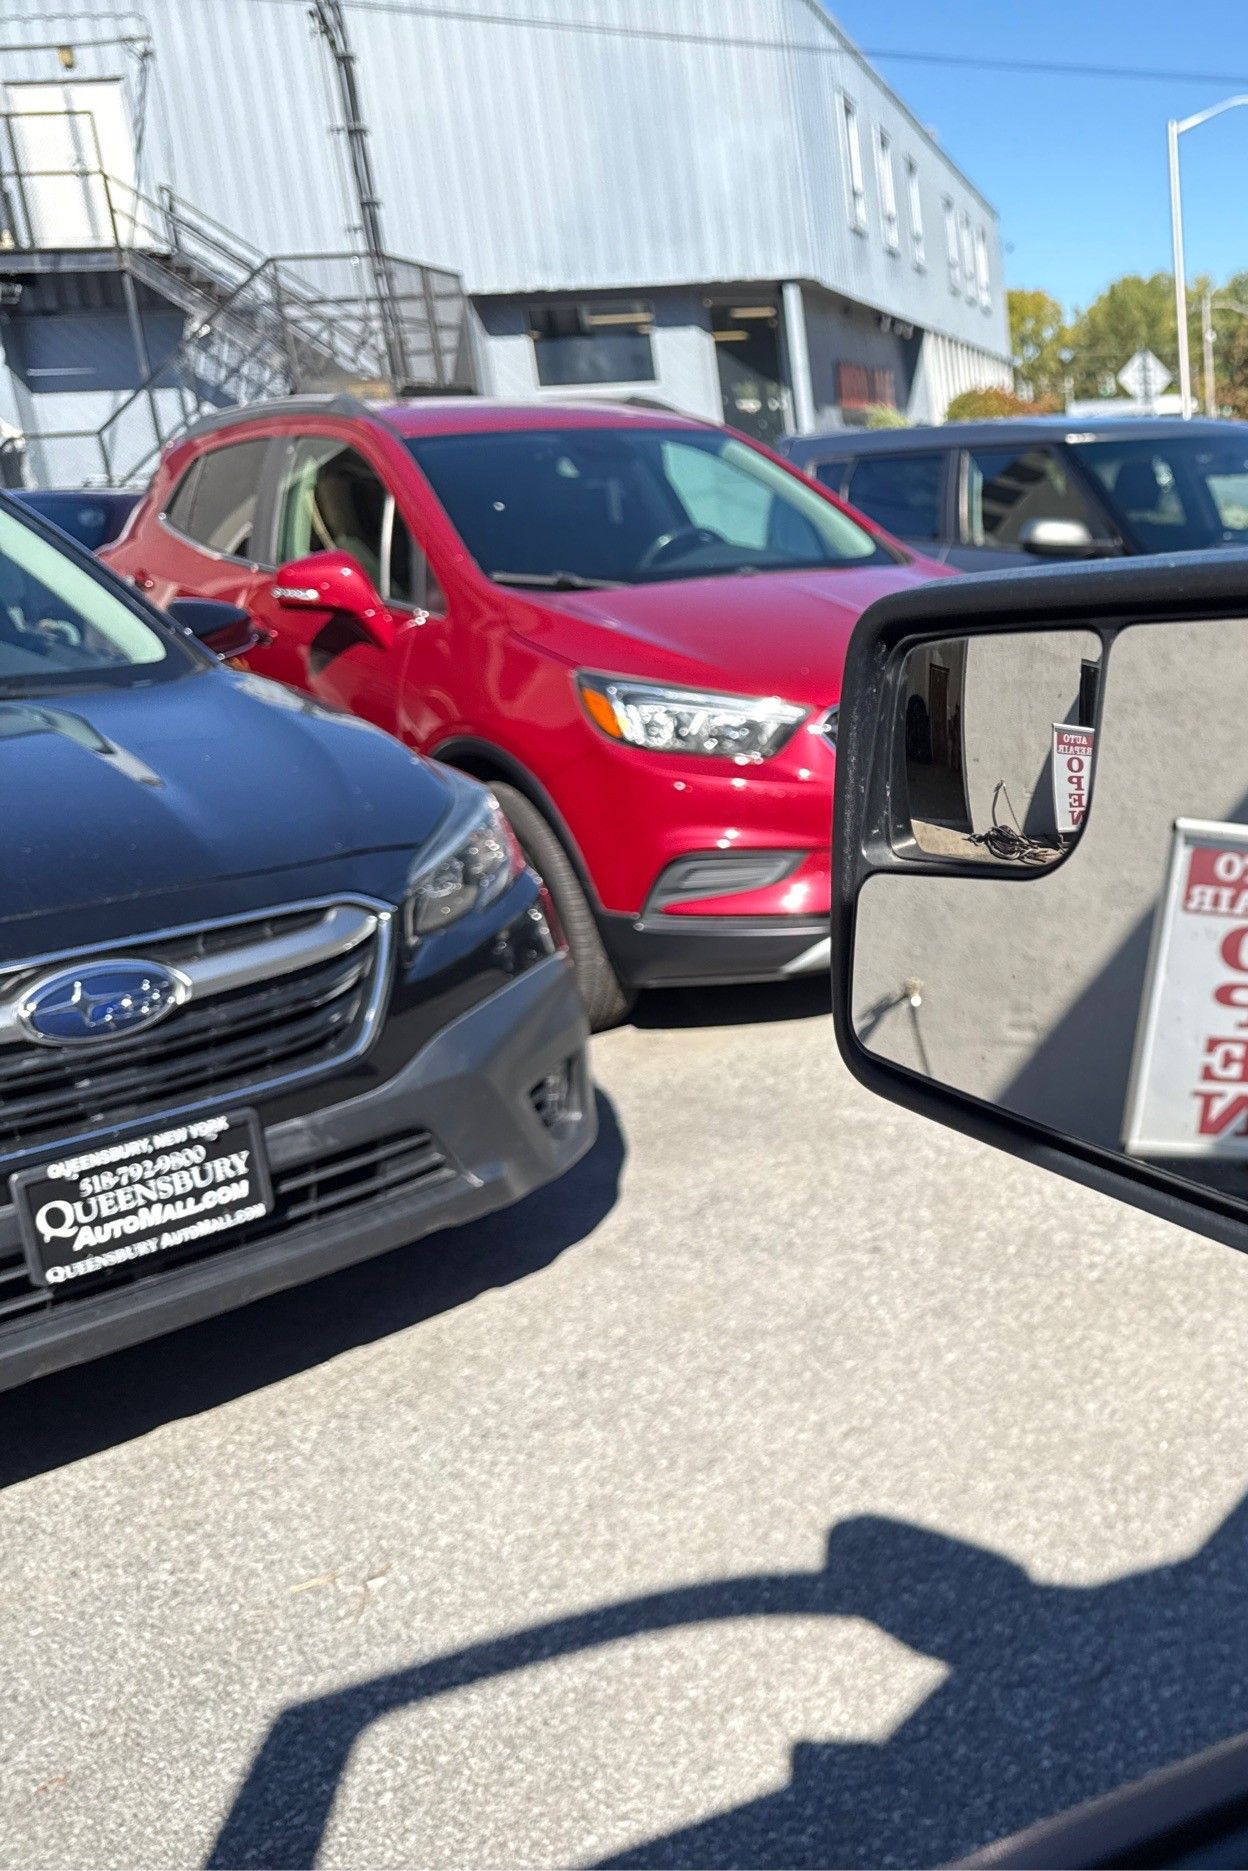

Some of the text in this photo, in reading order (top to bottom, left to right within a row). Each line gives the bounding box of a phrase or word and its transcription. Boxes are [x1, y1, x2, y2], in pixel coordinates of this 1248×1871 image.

[153, 1127, 188, 1149] NEW
[188, 1116, 229, 1139] YORK
[79, 1145, 206, 1197] 518-792-9800
[36, 1150, 250, 1242] QUEENSBURY
[45, 1237, 159, 1284] QUEENSBURY
